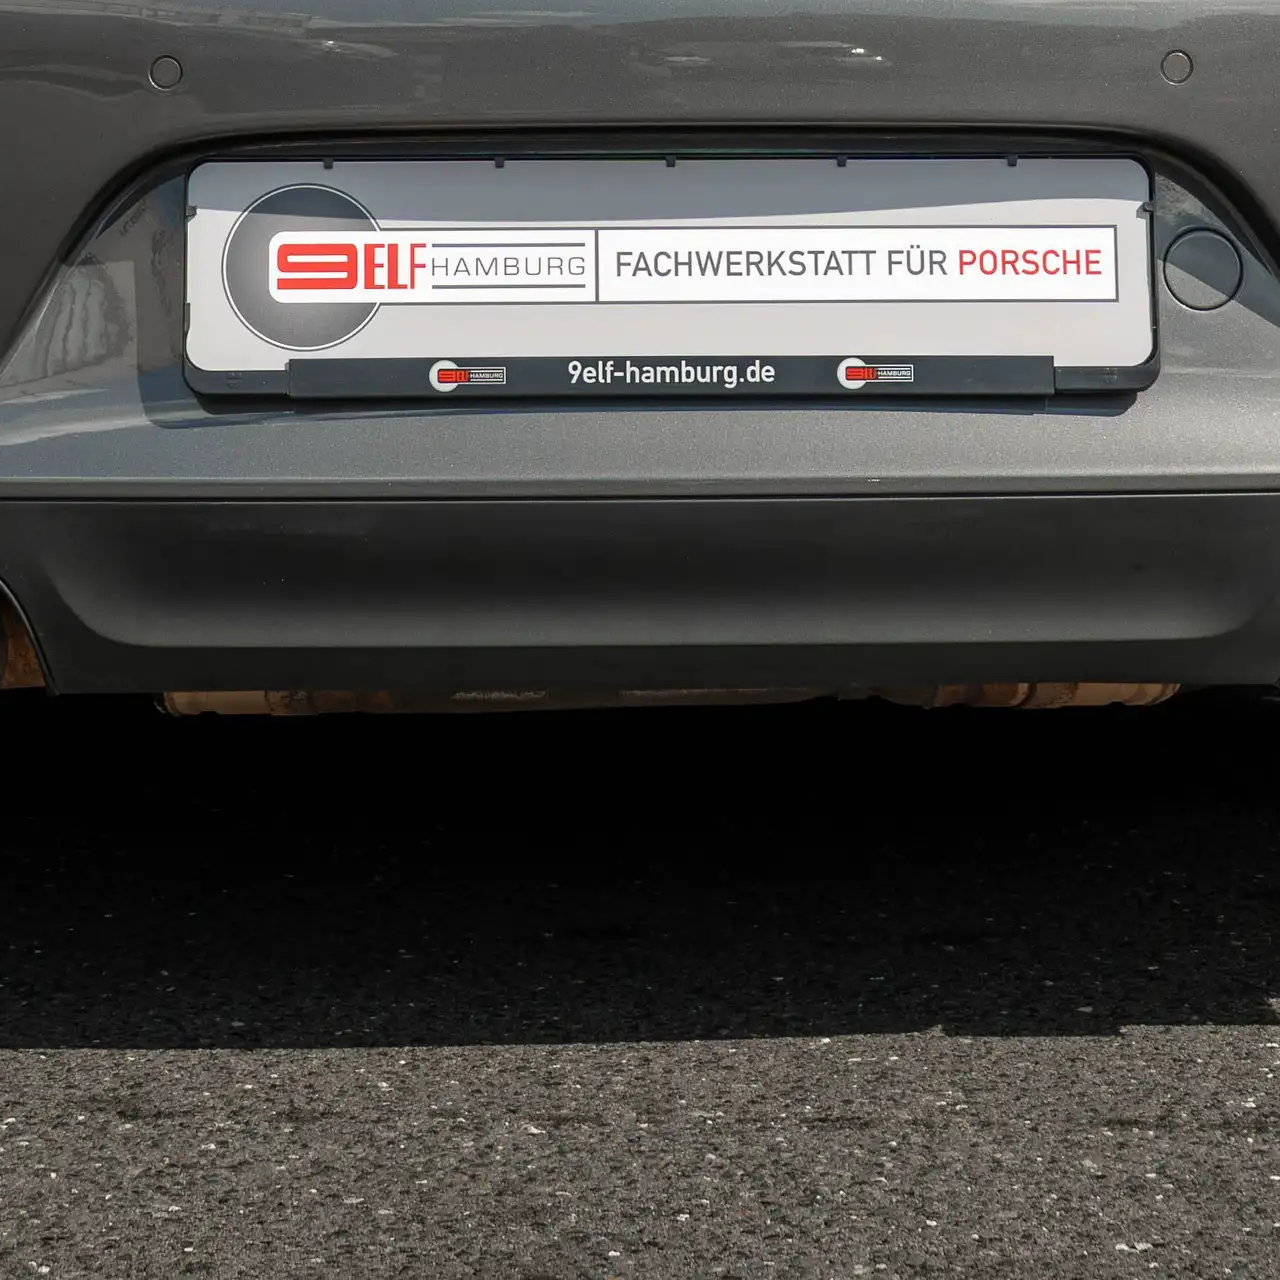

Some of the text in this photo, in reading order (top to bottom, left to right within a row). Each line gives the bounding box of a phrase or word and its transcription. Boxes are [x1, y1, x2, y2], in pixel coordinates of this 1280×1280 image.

[431, 256, 586, 277] HAMBURG
[615, 244, 1103, 278] FACHWERKSTATT FÜR PORSCHE
[567, 359, 776, 389] 9elf-hamburg.de
